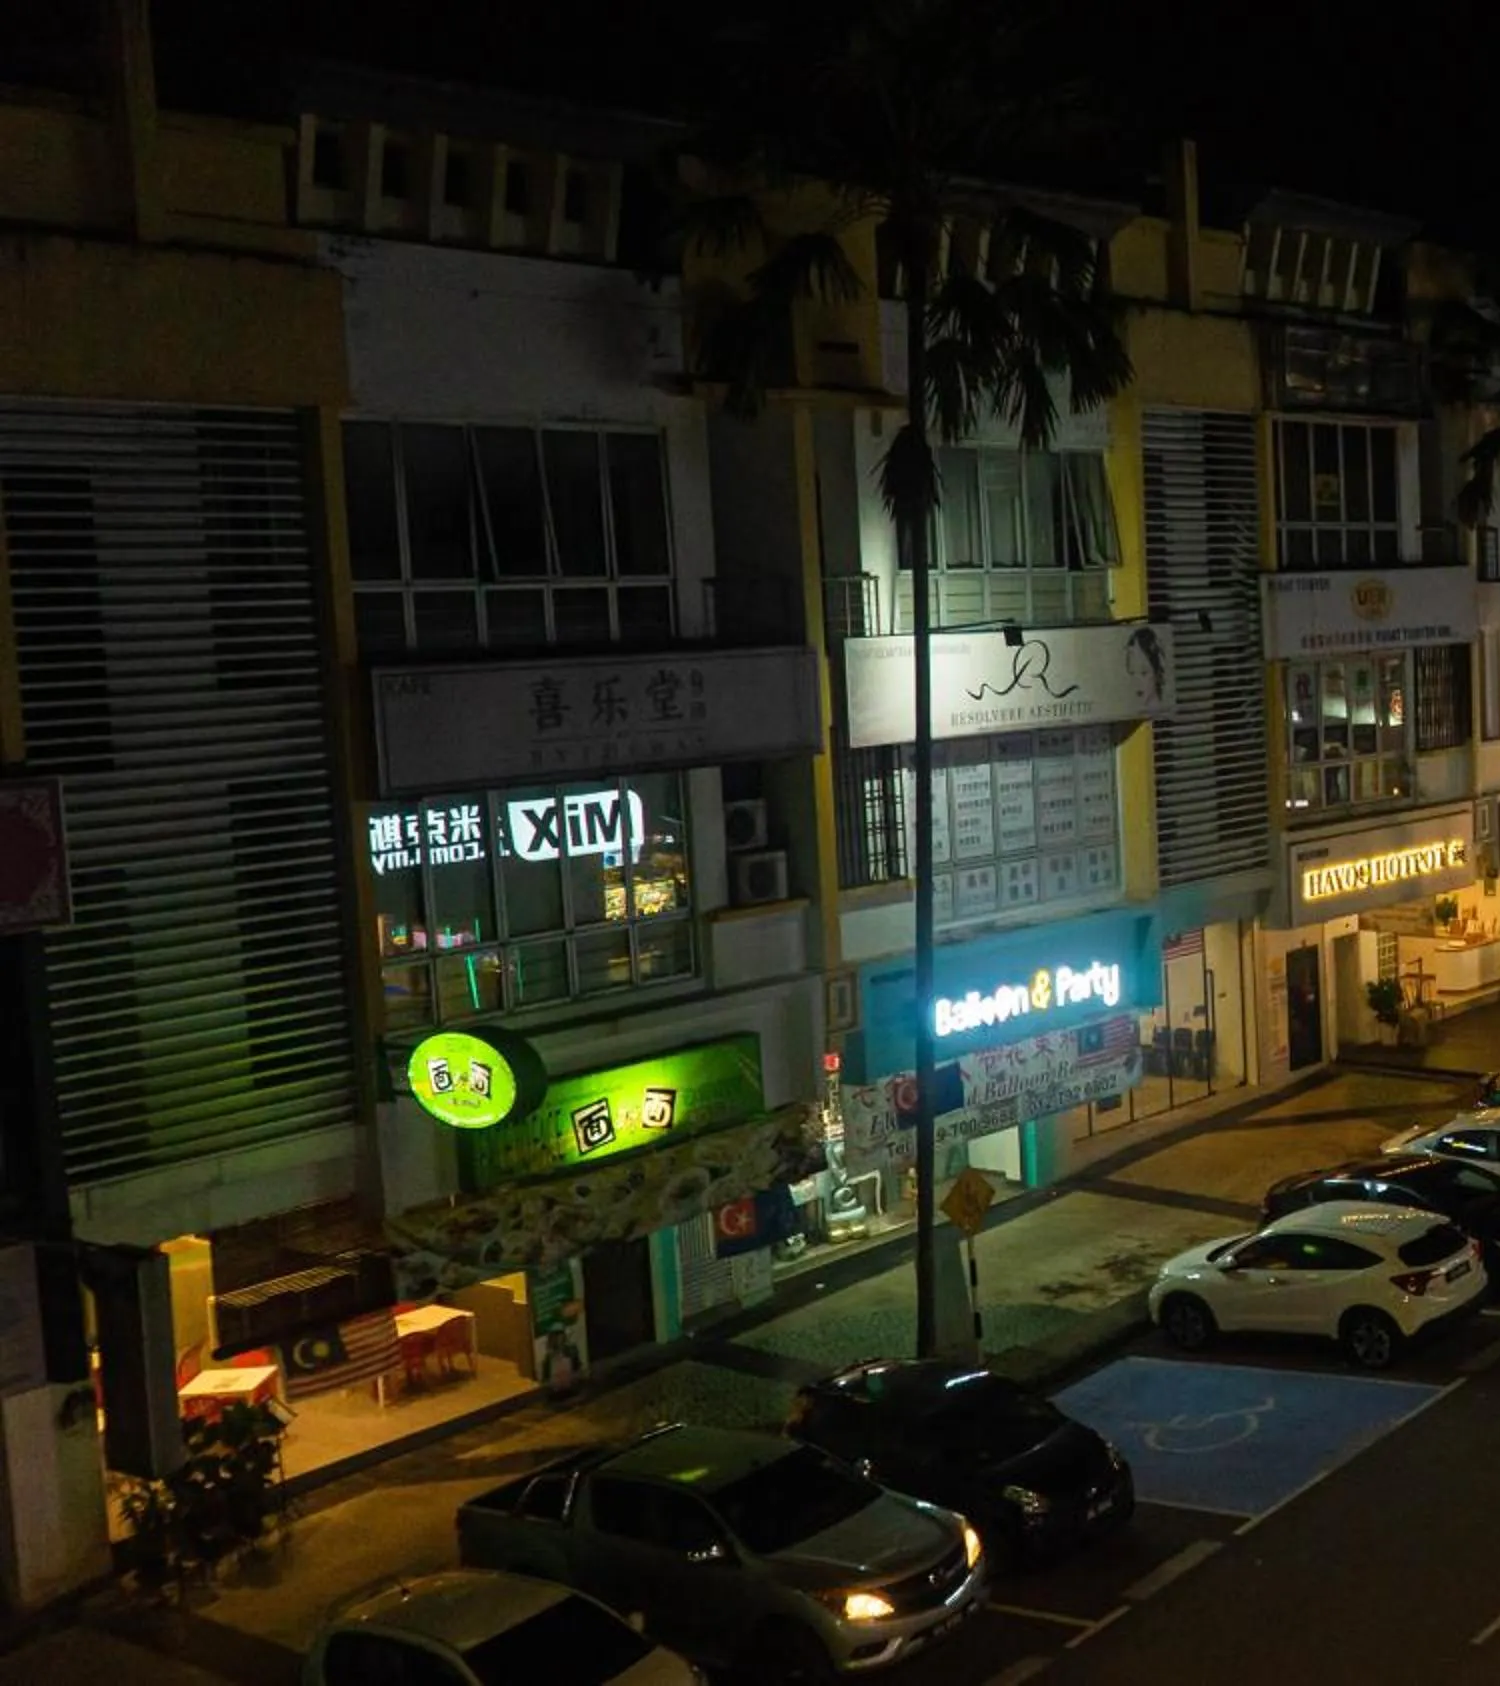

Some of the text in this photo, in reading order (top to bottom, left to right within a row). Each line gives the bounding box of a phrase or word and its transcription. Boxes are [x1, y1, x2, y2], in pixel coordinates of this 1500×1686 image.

[528, 669, 684, 735] 喜乐堂
[1303, 859, 1370, 900] HAVOC
[1370, 842, 1446, 886] HOTPOT
[935, 961, 1119, 1037] Balloon & Party
[984, 1069, 1051, 1102] Balloon
